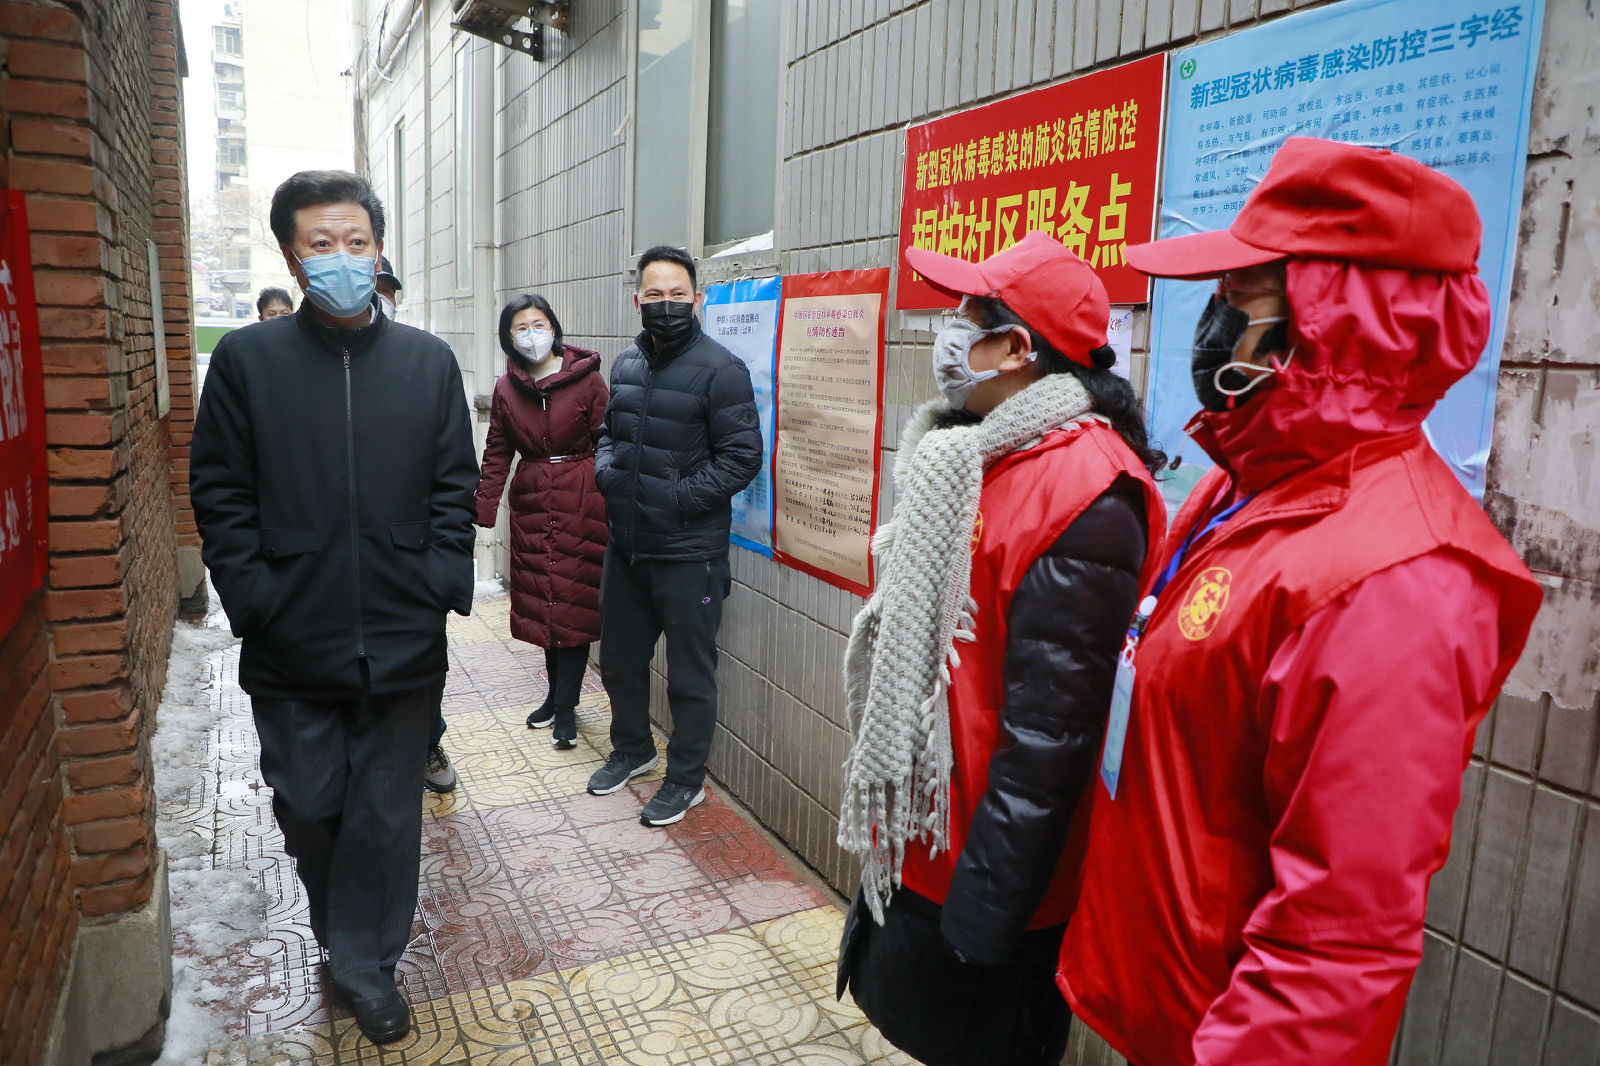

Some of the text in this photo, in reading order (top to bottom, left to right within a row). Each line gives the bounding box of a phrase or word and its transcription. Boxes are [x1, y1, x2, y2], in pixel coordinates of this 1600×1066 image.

[1190, 4, 1524, 110] 新型冠状病毒感染防控三字经
[915, 99, 1138, 191] 新型冠状病毒感染的肺炎疫情防控
